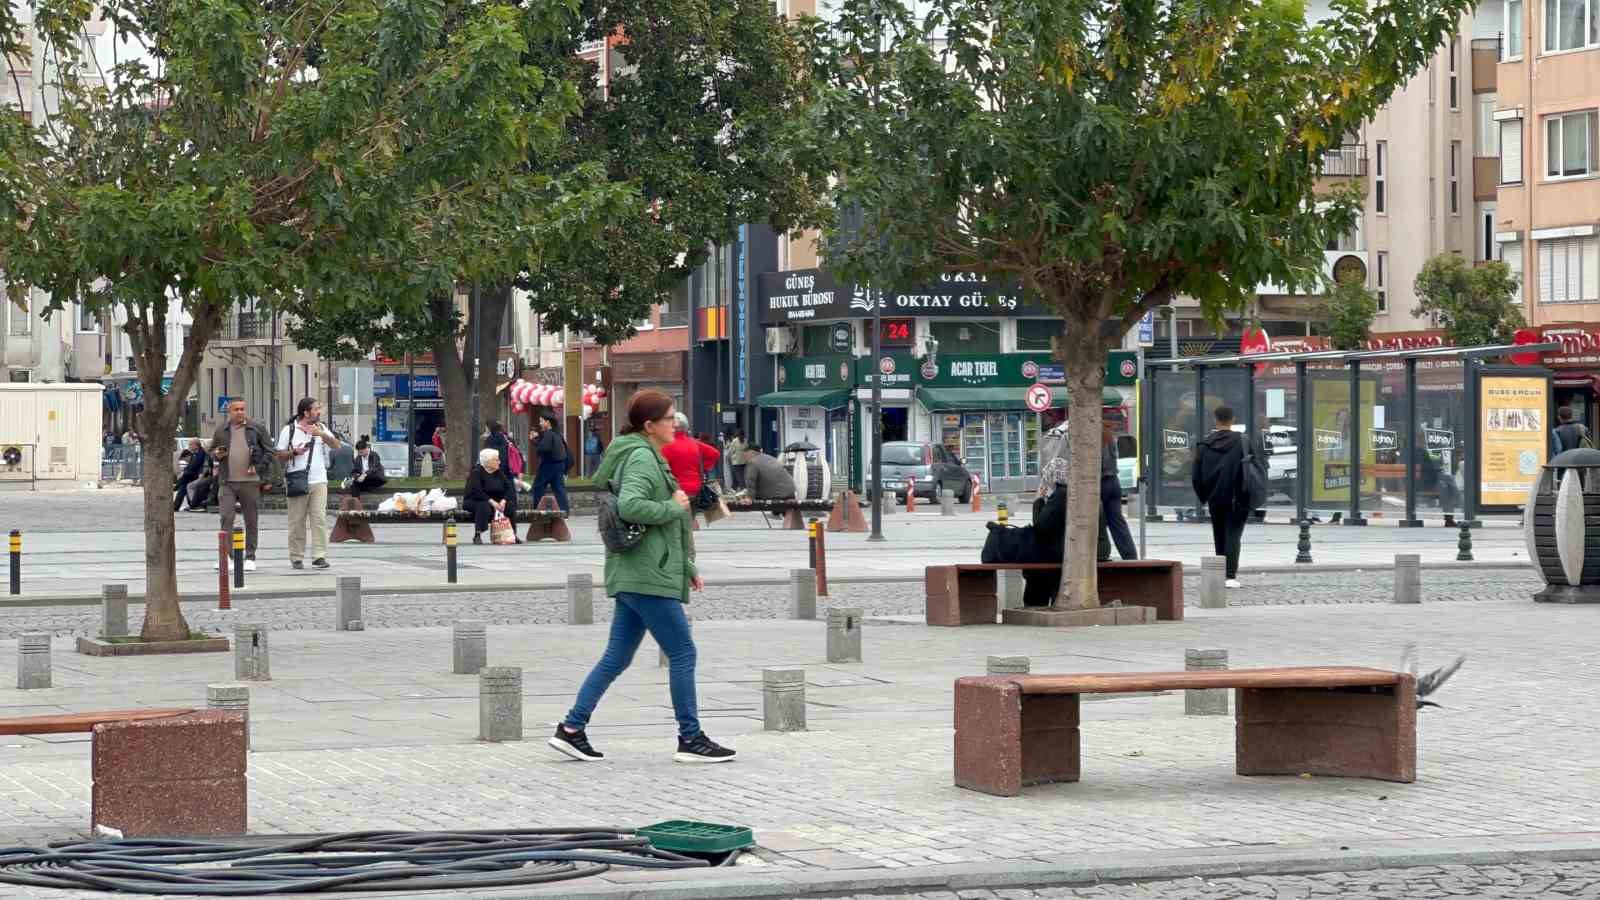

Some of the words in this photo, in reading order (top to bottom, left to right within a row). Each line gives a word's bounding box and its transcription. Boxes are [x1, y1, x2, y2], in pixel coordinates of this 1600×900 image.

[785, 273, 815, 290] GÜNEŞ
[770, 295, 800, 309] HUKUK
[802, 290, 835, 307] BÜROSU
[896, 294, 953, 307] OKTAY
[959, 291, 1018, 310] GÜEŞ
[951, 362, 973, 377] ACAR
[974, 361, 999, 376] TEKEL
